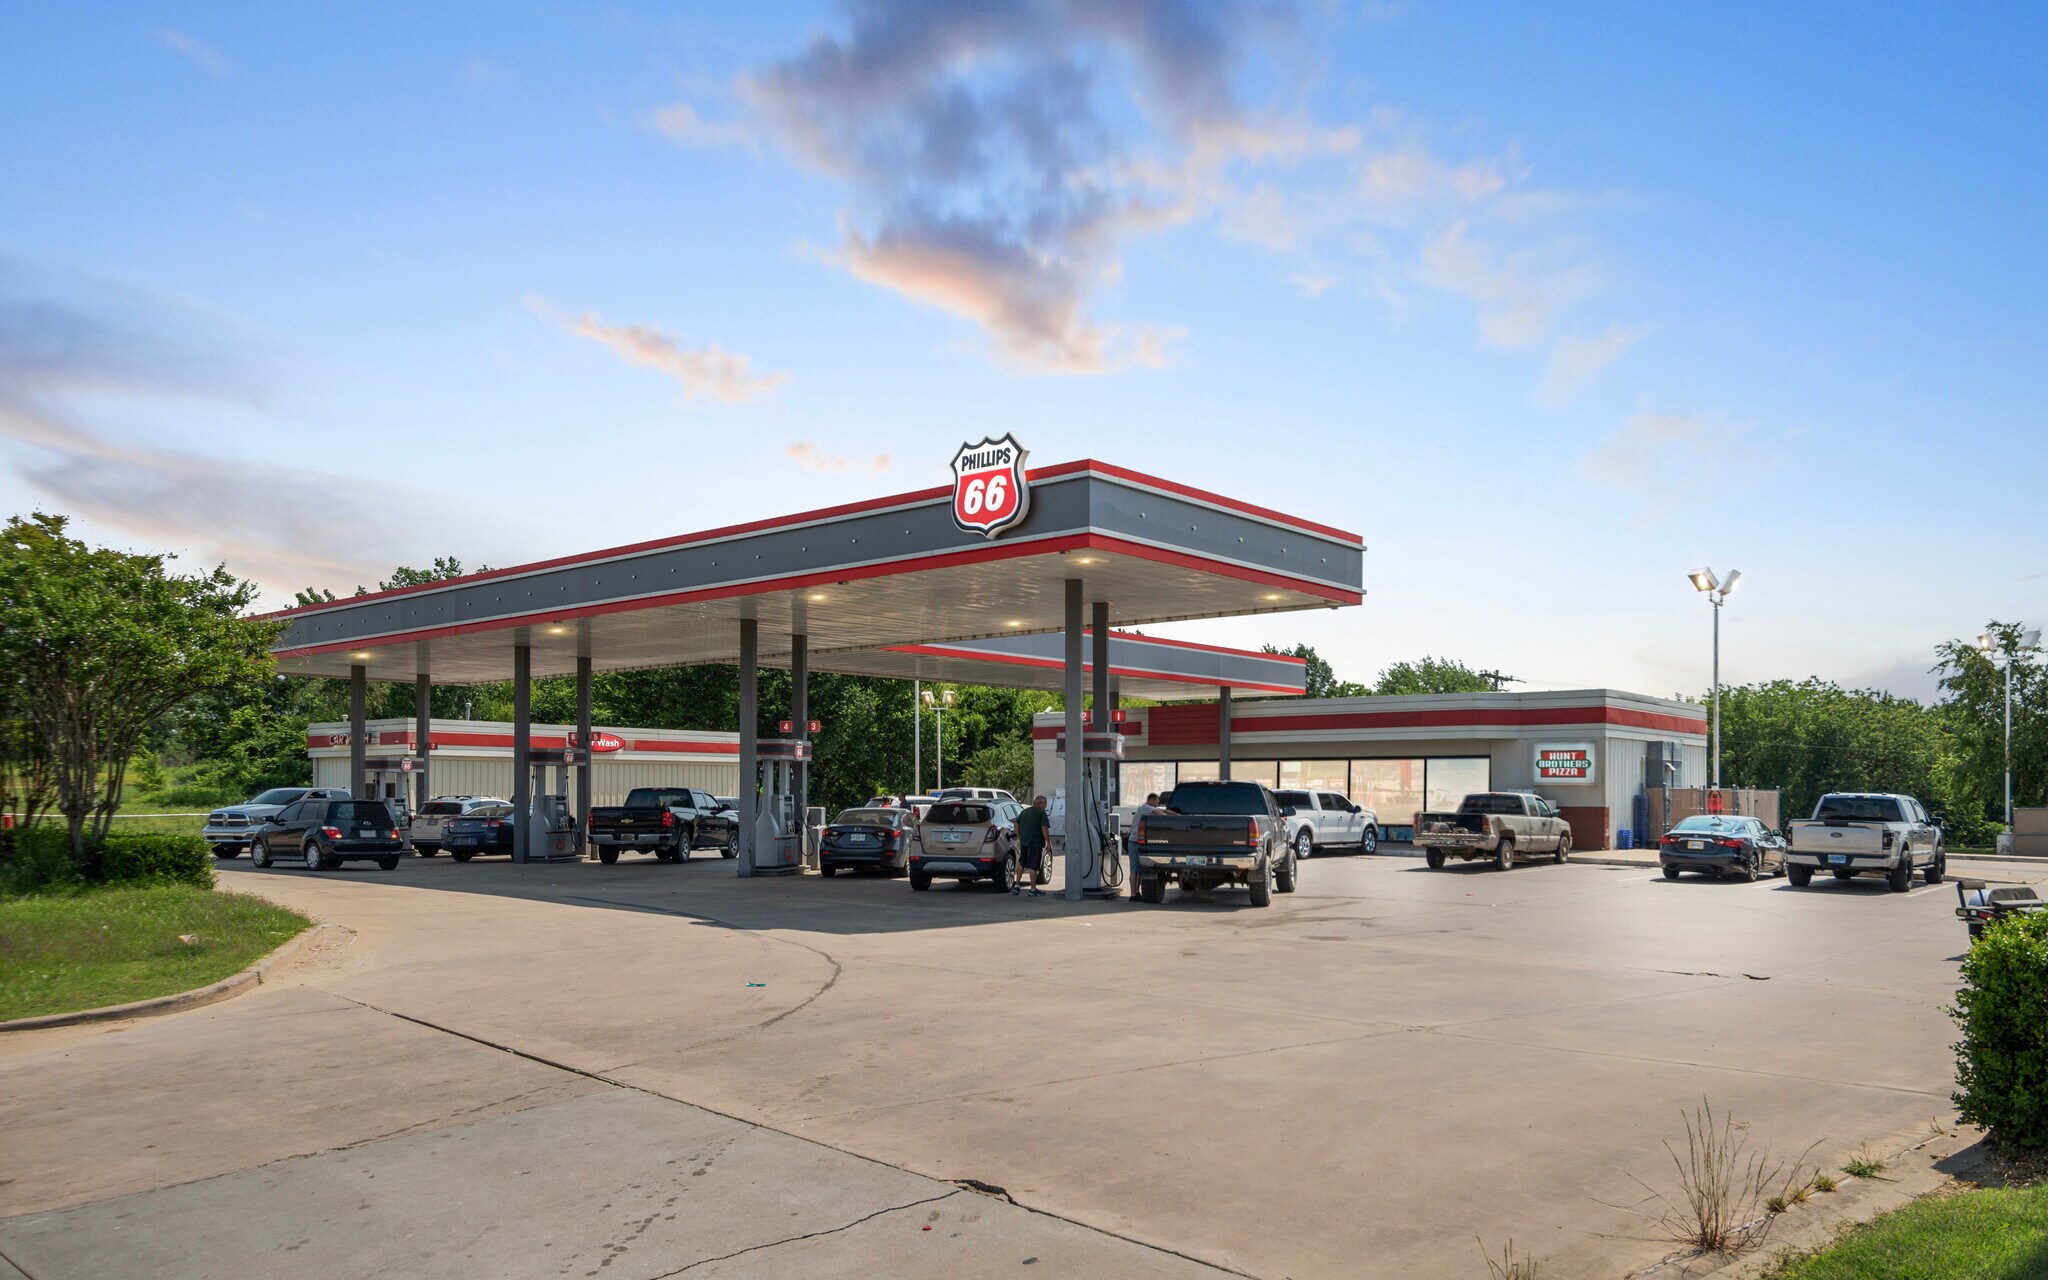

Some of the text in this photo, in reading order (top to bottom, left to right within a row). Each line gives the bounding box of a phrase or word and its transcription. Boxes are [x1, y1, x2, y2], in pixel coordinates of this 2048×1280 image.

[961, 447, 1011, 471] PHILLIPS
[963, 474, 1007, 515] 66
[1082, 712, 1087, 721] 2
[810, 722, 816, 731] 3
[330, 734, 344, 745] CAR
[598, 738, 619, 747] Wash
[1549, 752, 1577, 760] HUNT
[1538, 760, 1589, 768] BROTHERS
[1549, 768, 1578, 776] PIZZA
